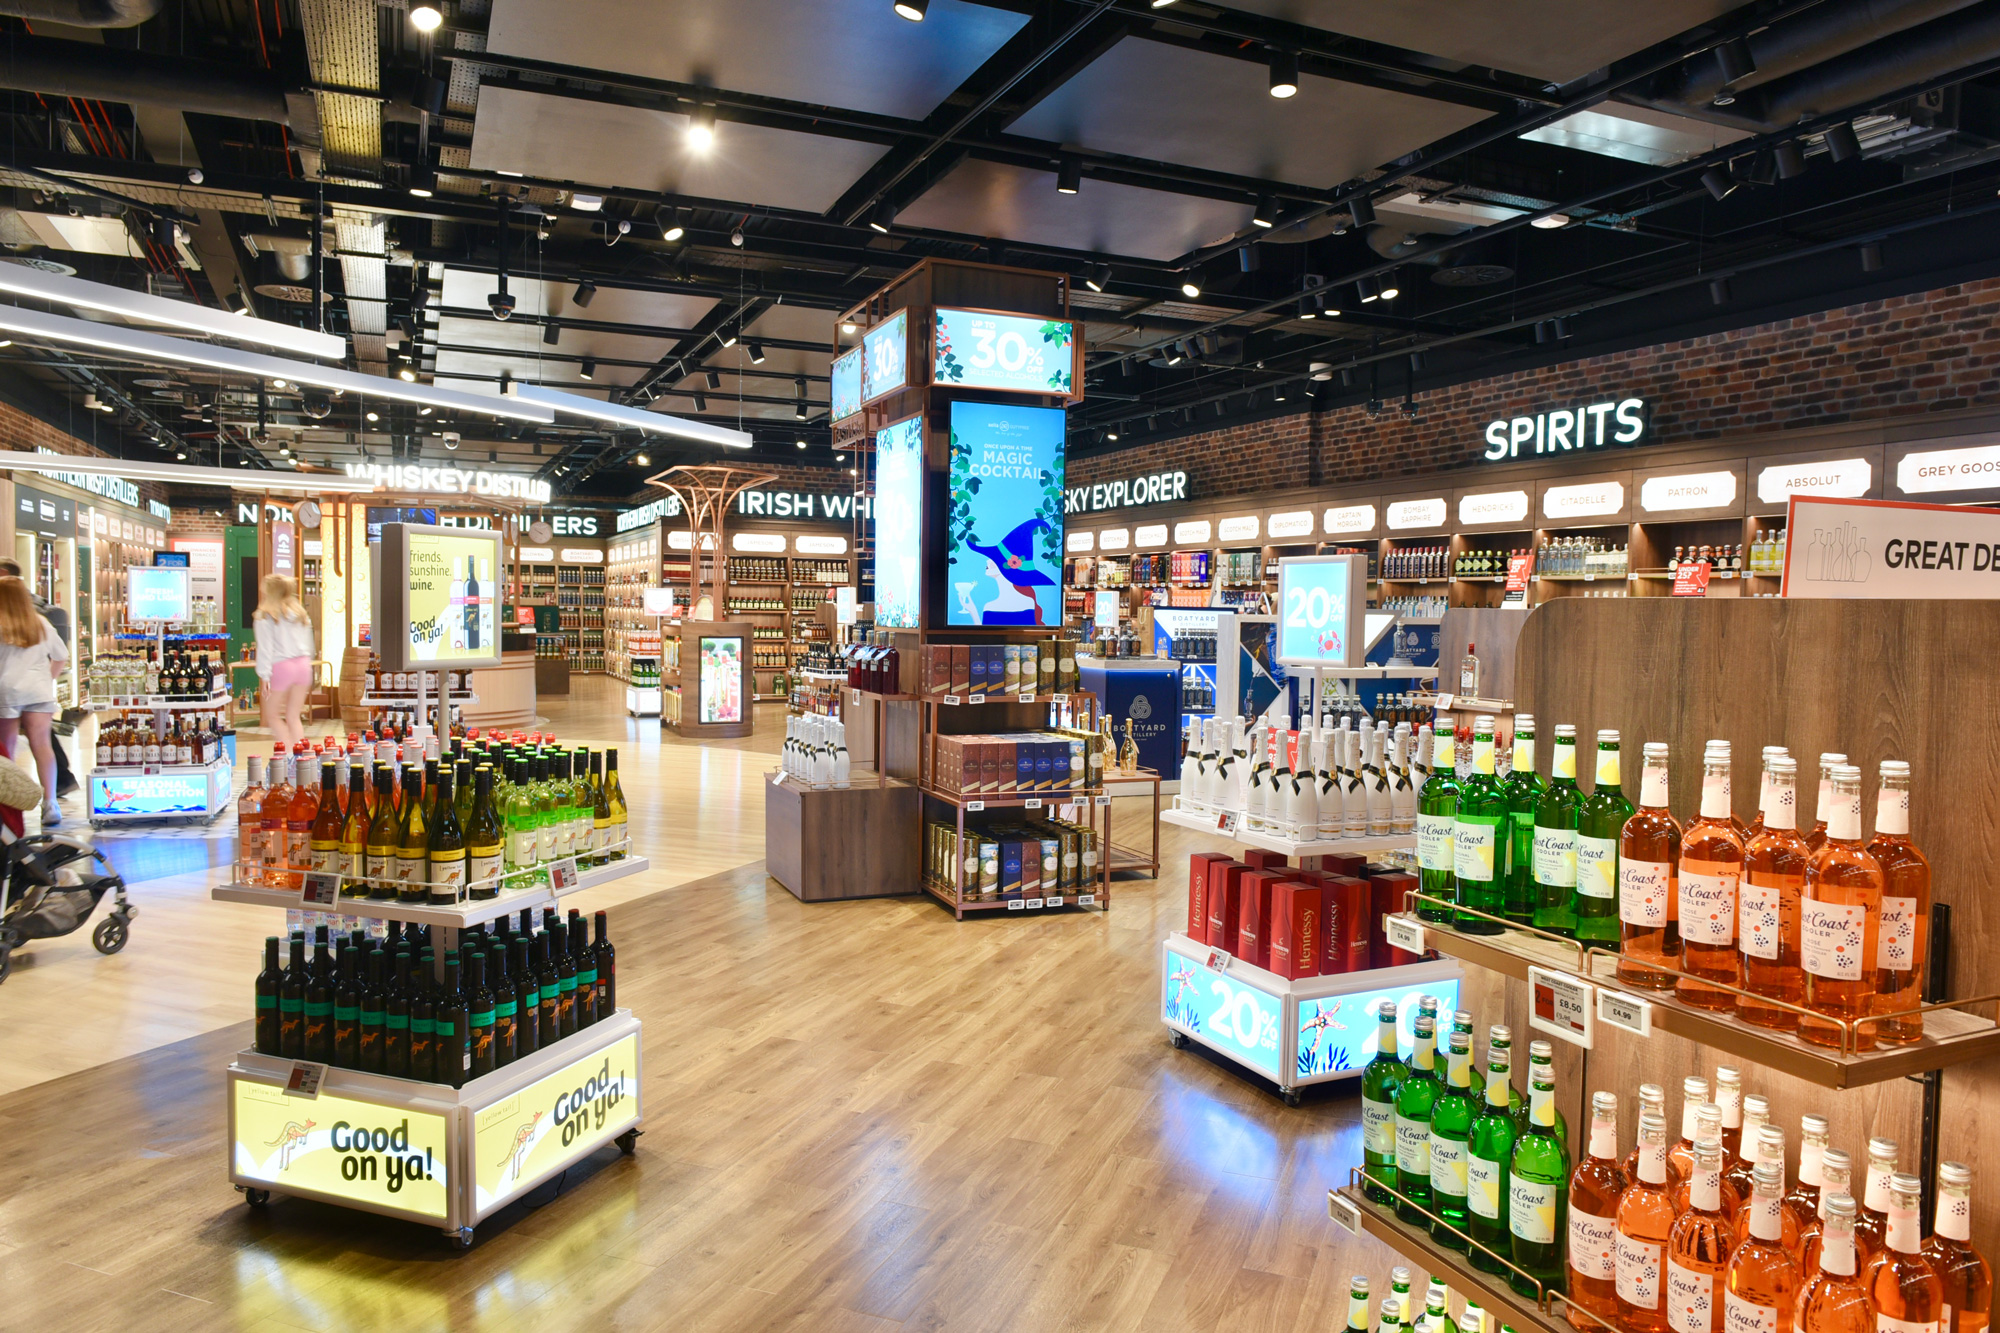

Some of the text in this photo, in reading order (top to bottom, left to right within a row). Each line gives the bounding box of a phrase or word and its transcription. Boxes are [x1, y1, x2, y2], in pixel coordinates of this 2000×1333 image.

[971, 319, 996, 330] UP TO
[968, 327, 1044, 373] 30%
[873, 337, 899, 382] 30%
[968, 367, 1043, 382] SELECTED ALCOHOLS
[1026, 365, 1044, 374] OFF
[1484, 398, 1644, 461] SPIRITS
[983, 450, 1033, 466] MAGIC
[345, 462, 474, 494] WHISKEY
[969, 463, 1046, 481] COCKTAIL
[1917, 464, 1956, 478] GREY
[1785, 474, 1841, 489] ABSOLUT
[1092, 470, 1187, 511] EXPLORER
[1667, 485, 1708, 497] PATRON
[739, 490, 813, 517] IRISH
[1559, 494, 1606, 506] CITADELLE
[1337, 511, 1362, 519] CAPTAIN
[1402, 504, 1430, 514] BOMBAY
[1471, 502, 1514, 514] HENDRICKS
[1273, 520, 1308, 529] DIPLOMATICO
[1336, 520, 1362, 528] MORGAN
[1400, 513, 1432, 524] SAPPHIRE
[1242, 524, 1255, 532] MALT
[158, 558, 167, 566] 2
[409, 549, 444, 565] friends.
[1884, 538, 2000, 573] GREAT DE
[409, 565, 452, 577] sunshine.
[1676, 571, 1693, 580] 25?
[145, 587, 174, 595] FRESH
[409, 578, 435, 591] wine.
[1287, 586, 1345, 629] 20%
[409, 615, 436, 634] Good
[1329, 613, 1344, 623] OFF
[412, 623, 444, 644] on ya!
[1113, 723, 1167, 732] BOTYARD
[122, 780, 190, 790] SEASONAL
[135, 788, 205, 798] SELECTION
[1426, 823, 1452, 836] Coast
[1459, 831, 1485, 845] Coast
[1545, 836, 1575, 851] Coast
[1536, 848, 1561, 857] COOLER
[1625, 867, 1657, 885] Coast
[1688, 883, 1723, 900] Coast
[1192, 873, 1204, 928] Hennessy
[1208, 916, 1223, 928] Hennessy
[1812, 910, 1851, 931] Coast
[1880, 910, 1903, 923] ast
[1240, 928, 1256, 940] Hennessy
[1327, 900, 1339, 961] Hennessy
[1802, 925, 1832, 938] COOLER
[1299, 907, 1315, 970] Hennessy
[1350, 939, 1367, 948] Hennessy
[1806, 937, 1821, 946] ROSÉ
[1272, 942, 1290, 954] Hennessy
[1809, 958, 1818, 967] 88
[1550, 978, 1563, 987] COAST
[1563, 982, 1578, 992] COOLER
[1535, 989, 1541, 1003] 2
[1559, 998, 1582, 1014] £8.50
[1208, 980, 1279, 1050] 20%
[1612, 1008, 1632, 1020] £4.99
[1260, 1037, 1277, 1052] OFF
[553, 1056, 610, 1127] Good
[561, 1068, 625, 1148] on ya!
[1366, 1106, 1390, 1122] Coast
[330, 1118, 409, 1153] Good
[1403, 1125, 1430, 1141] Coast
[1434, 1143, 1460, 1160] Coast
[340, 1146, 433, 1194] on ya!
[1516, 1186, 1546, 1205] Coast
[1571, 1229, 1599, 1246] COOLER
[1581, 1220, 1614, 1240] Coast
[1576, 1242, 1591, 1252] ROSÉ
[1618, 1242, 1648, 1266] Coast
[1669, 1271, 1699, 1296] Coast
[1728, 1303, 1762, 1330] Coast
